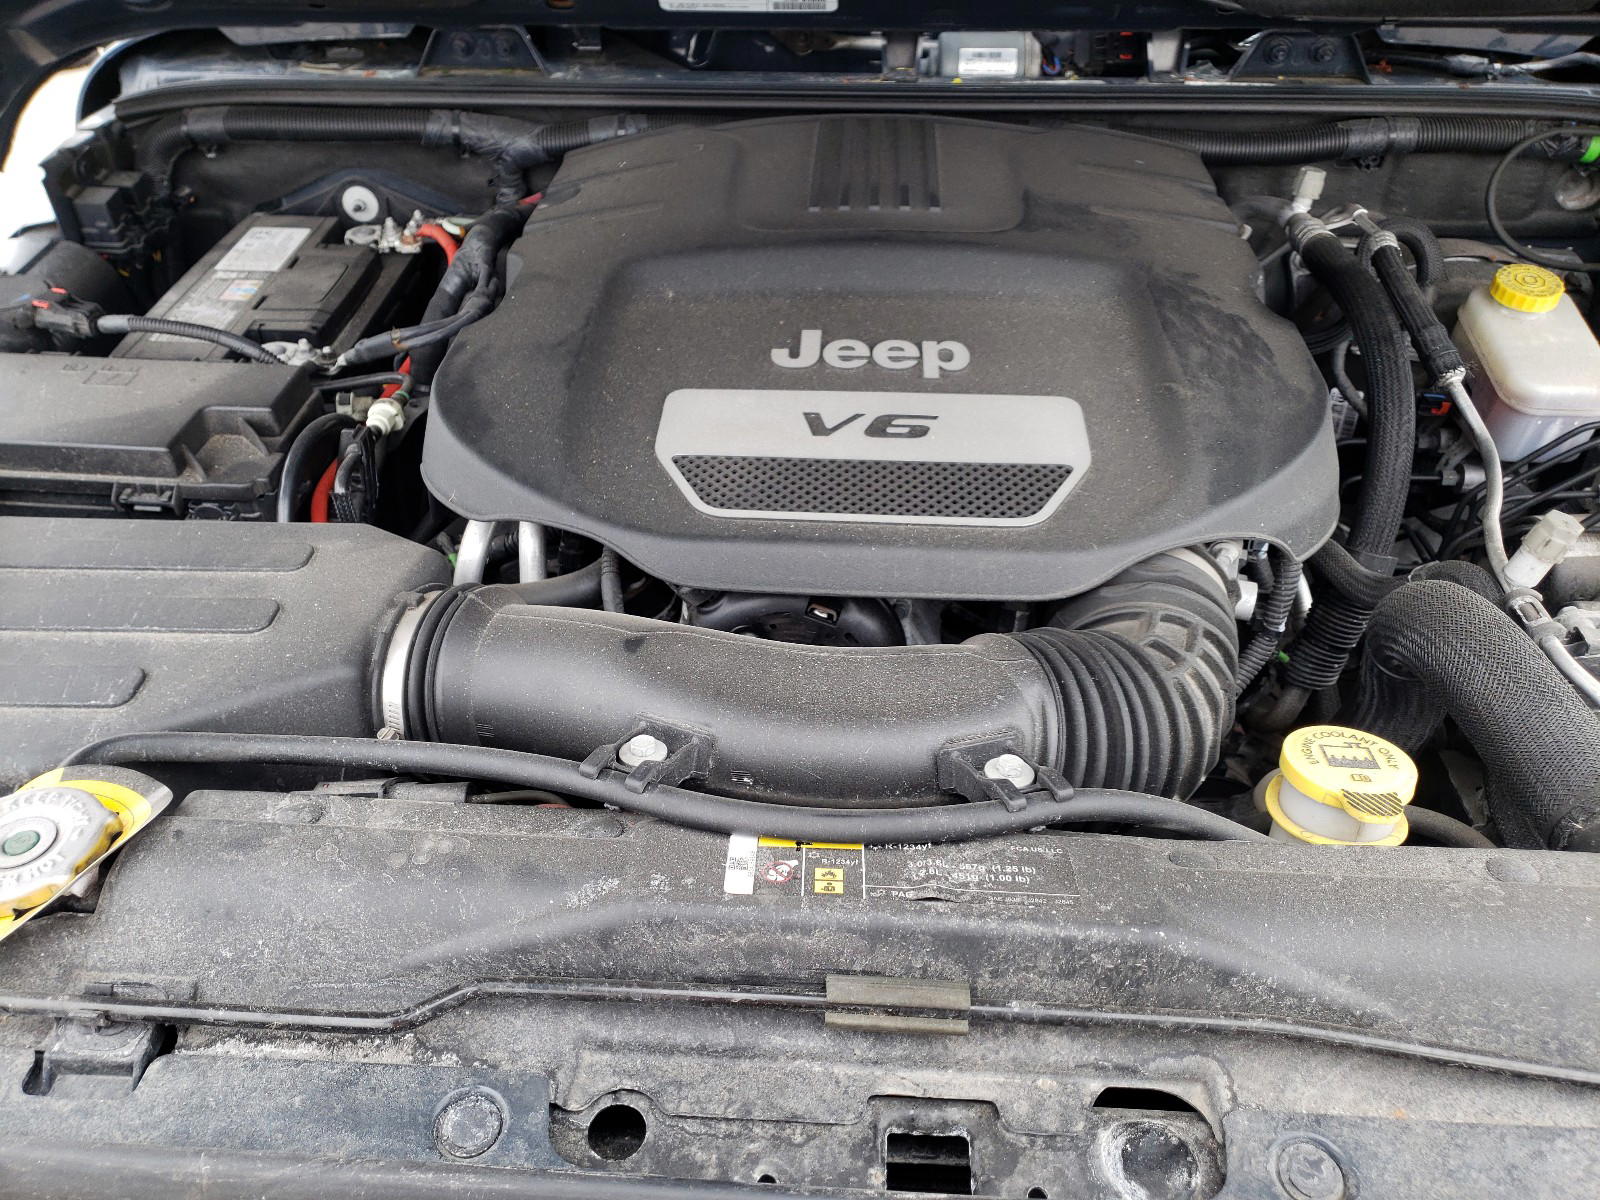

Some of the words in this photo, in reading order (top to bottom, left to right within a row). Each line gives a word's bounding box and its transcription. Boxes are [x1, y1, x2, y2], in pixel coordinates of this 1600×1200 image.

[770, 329, 971, 379] Jeep
[803, 412, 939, 438] V6
[1301, 736, 1320, 765] ENGINE
[1313, 730, 1379, 747] COOLANT
[1378, 747, 1400, 769] ONLY
[992, 864, 1019, 873] (1.25
[1021, 865, 1036, 875] lb)
[986, 874, 1012, 882] (1.00
[1015, 874, 1030, 884] lb)
[891, 890, 914, 898] PAG
